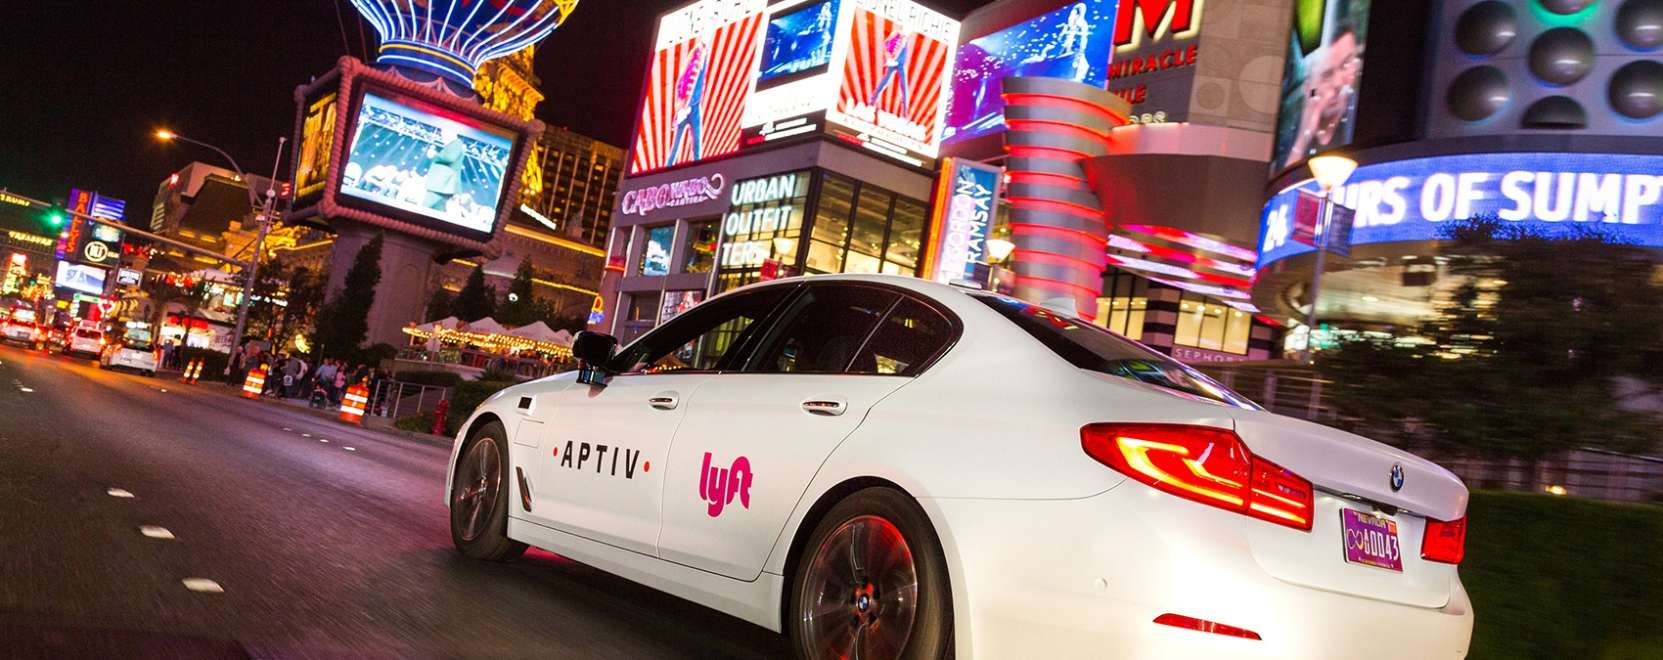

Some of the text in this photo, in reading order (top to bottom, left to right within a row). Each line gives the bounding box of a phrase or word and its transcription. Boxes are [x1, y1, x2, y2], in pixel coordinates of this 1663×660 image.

[1107, 43, 1198, 80] MIRACLE
[1113, 83, 1147, 105] ILE
[732, 173, 797, 206] URBAN
[1331, 175, 1411, 228] URS
[1420, 172, 1490, 222] OF
[1497, 170, 1663, 225] SUMP
[726, 205, 793, 236] OUTFIT
[964, 183, 993, 264] RAMSAY
[721, 238, 770, 267] TERS
[560, 440, 640, 480] APTIV
[699, 451, 754, 518] lyft
